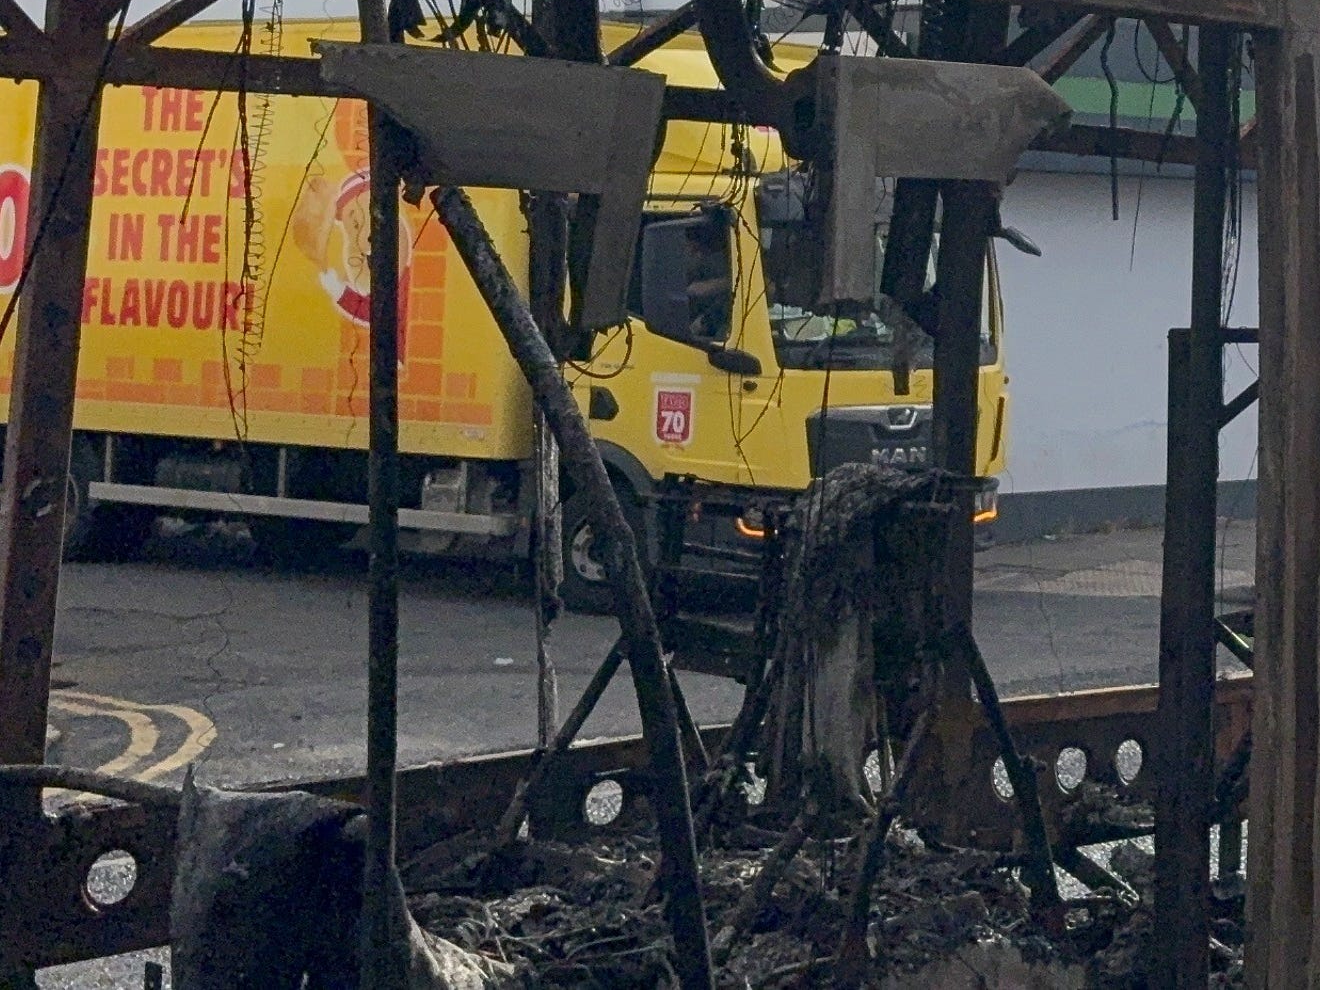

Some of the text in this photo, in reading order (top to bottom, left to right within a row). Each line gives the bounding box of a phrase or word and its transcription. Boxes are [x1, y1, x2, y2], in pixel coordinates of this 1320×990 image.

[142, 86, 205, 131] THE
[92, 147, 249, 199] SECRET'S
[108, 213, 223, 264] IN THE
[660, 410, 686, 434] 70
[871, 446, 928, 465] MAN
